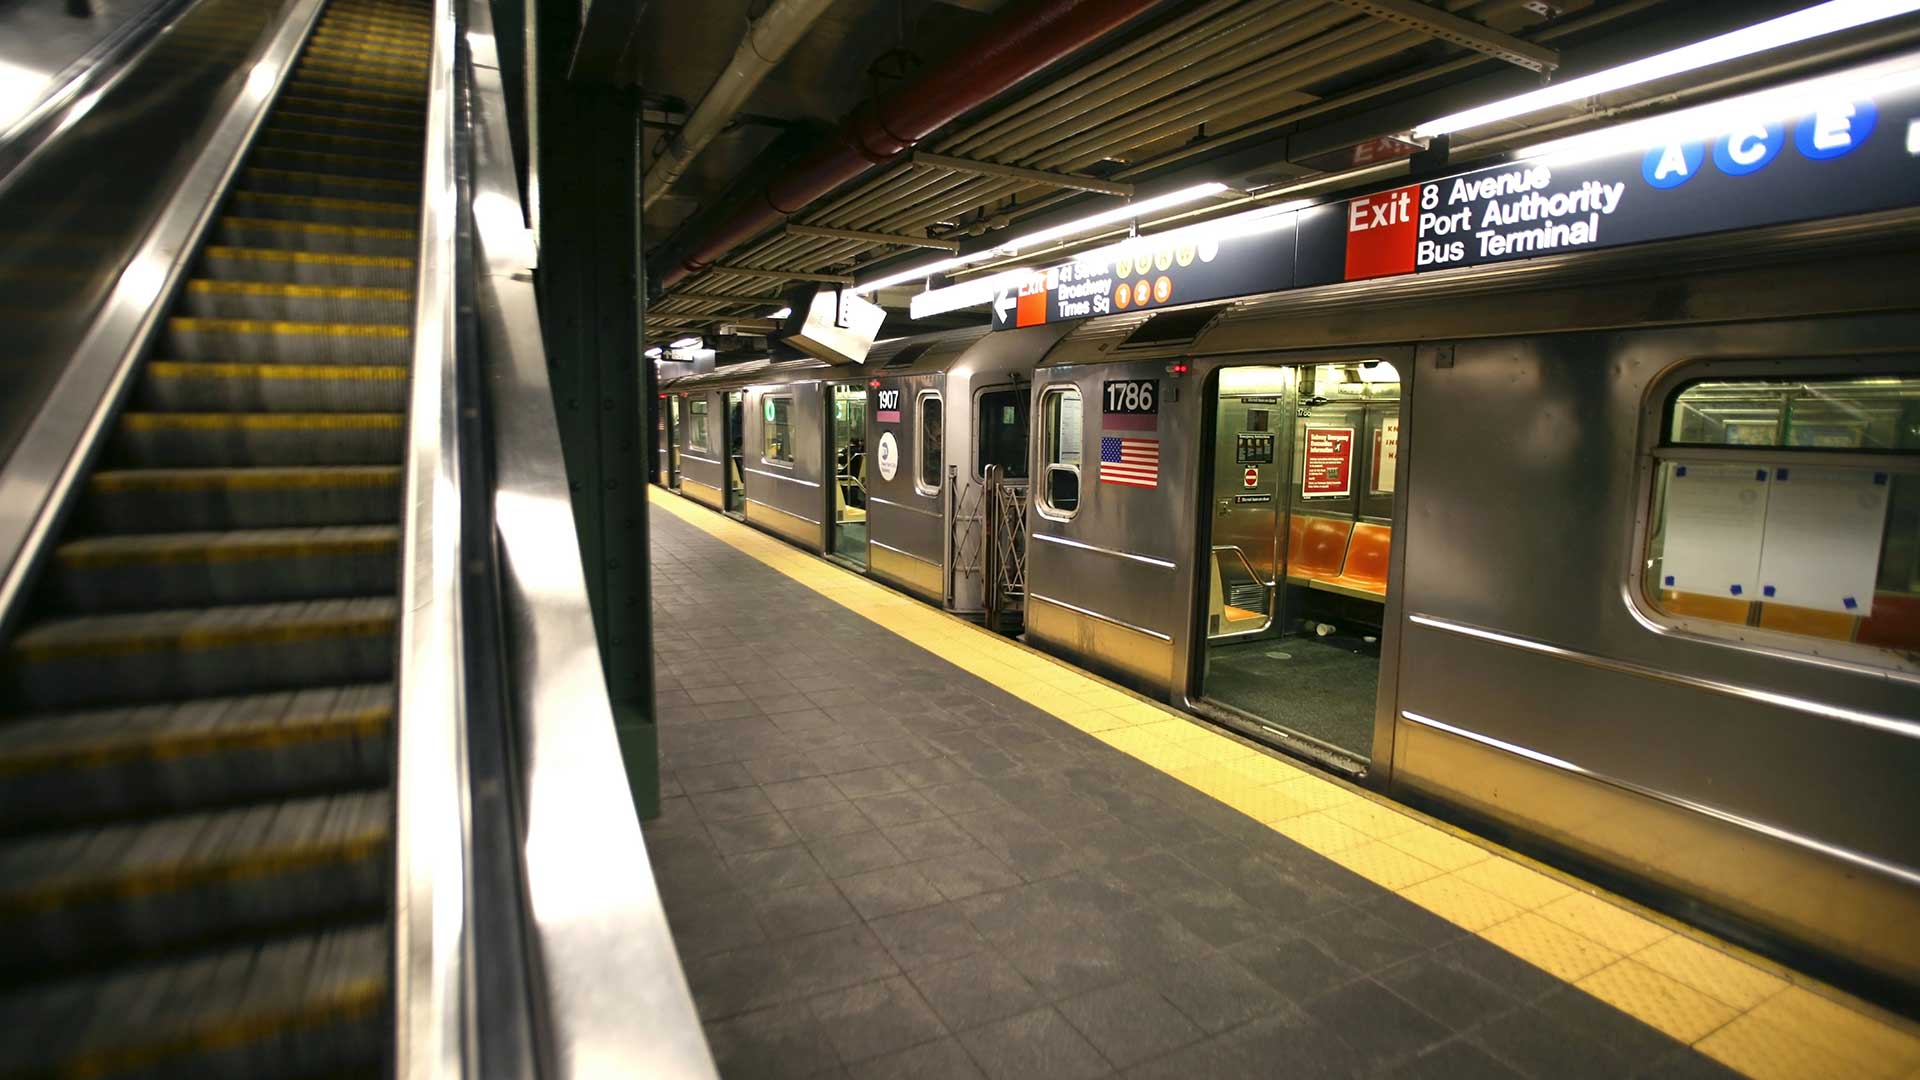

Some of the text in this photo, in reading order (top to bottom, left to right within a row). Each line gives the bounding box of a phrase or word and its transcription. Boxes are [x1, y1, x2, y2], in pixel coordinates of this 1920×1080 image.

[1654, 102, 1856, 180] A C E
[1421, 166, 1551, 210] 8 Avenue
[1350, 192, 1411, 232] Exit
[1418, 181, 1625, 238] Port Authority
[1417, 213, 1599, 266] Bus Terminal
[1058, 278, 1112, 301] Broadway
[1058, 294, 1110, 318] Times Sq
[878, 390, 899, 410] 1907
[1107, 382, 1153, 411] 1786
